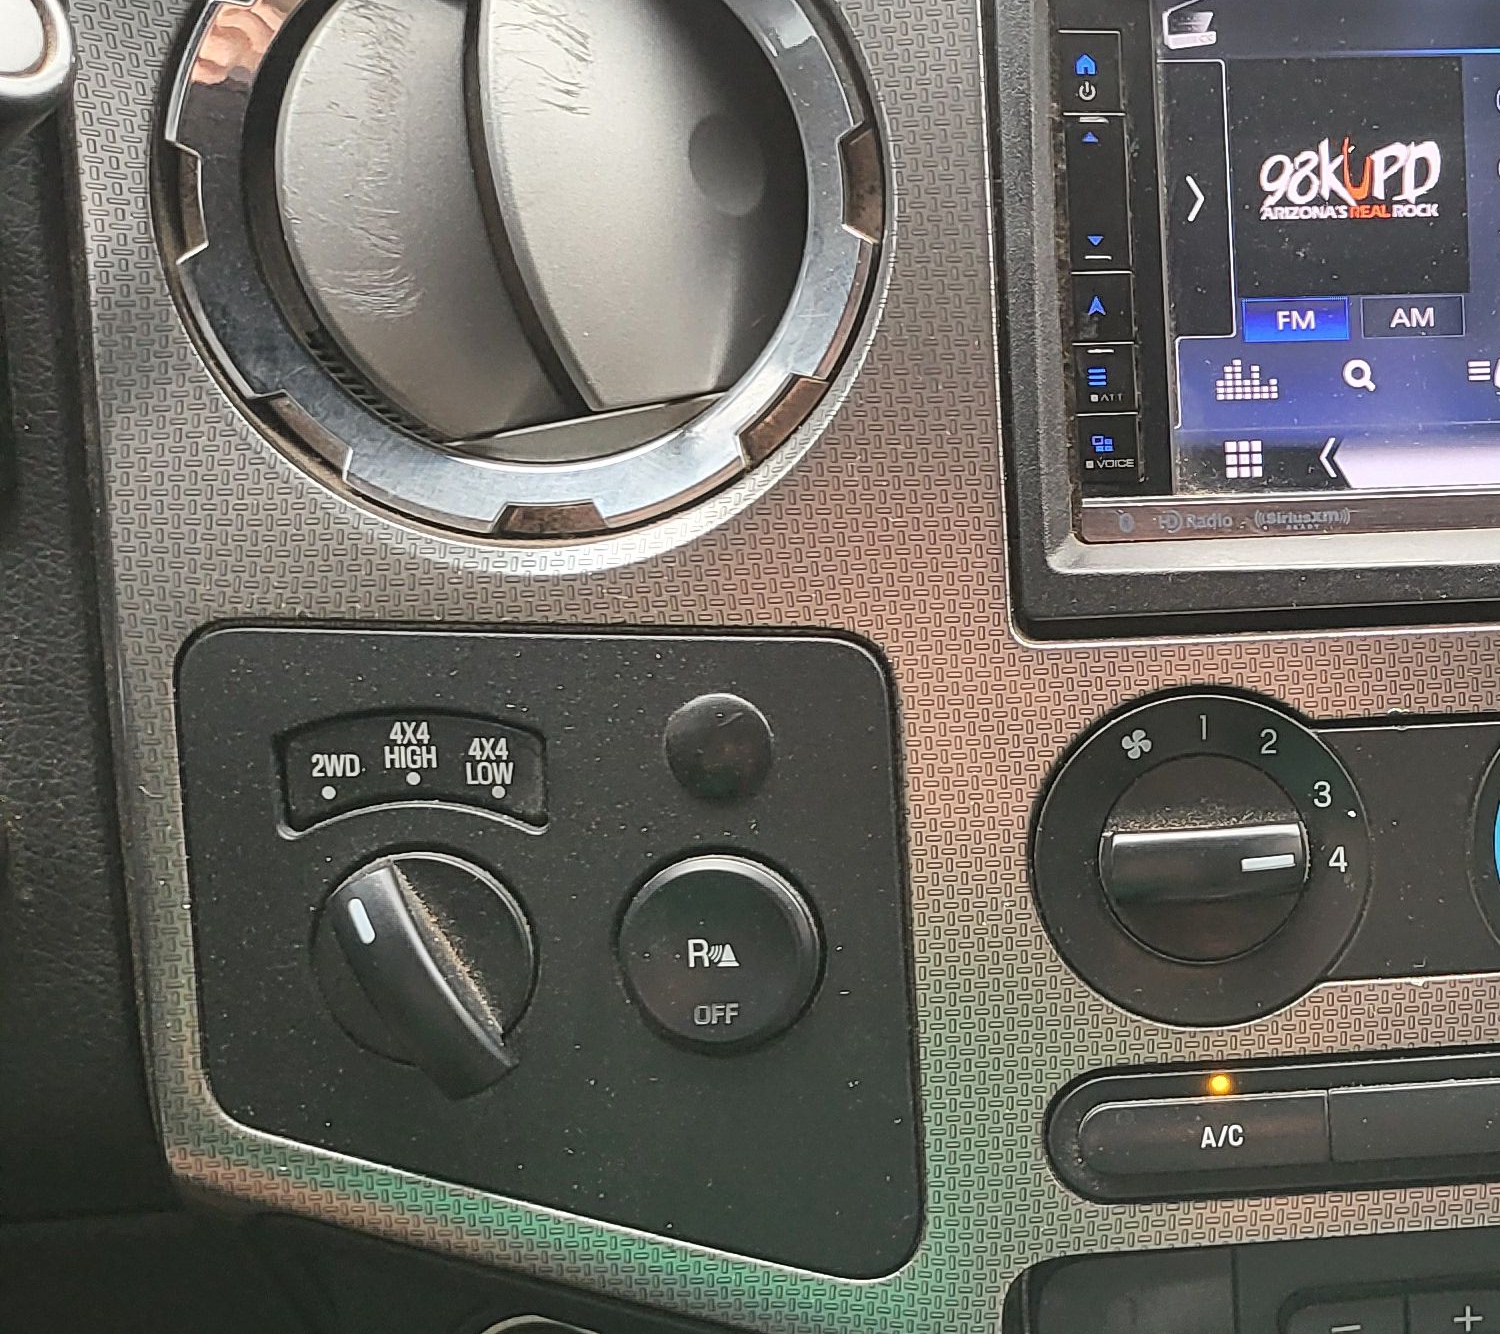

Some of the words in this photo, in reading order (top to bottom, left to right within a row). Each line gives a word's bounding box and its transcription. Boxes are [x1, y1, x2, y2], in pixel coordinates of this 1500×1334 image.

[1260, 137, 1442, 206] 98KUPD
[1260, 203, 1348, 221] ARIZONA'S
[1349, 203, 1392, 219] REAL
[1392, 202, 1440, 219] ROCK
[1276, 309, 1314, 329] FM
[1389, 307, 1436, 329] AM
[1097, 458, 1135, 469] VOICE
[388, 721, 430, 745] 4X4
[1199, 714, 1208, 739] 1
[467, 737, 509, 761] 4X4
[1259, 728, 1279, 753] 2
[310, 753, 360, 777] 2WD
[383, 744, 438, 769] HIGH
[464, 760, 514, 786] LOW
[1313, 780, 1333, 806] 3
[1328, 846, 1349, 871] 4
[693, 1002, 741, 1026] OFF
[1200, 1124, 1245, 1148] A/C
